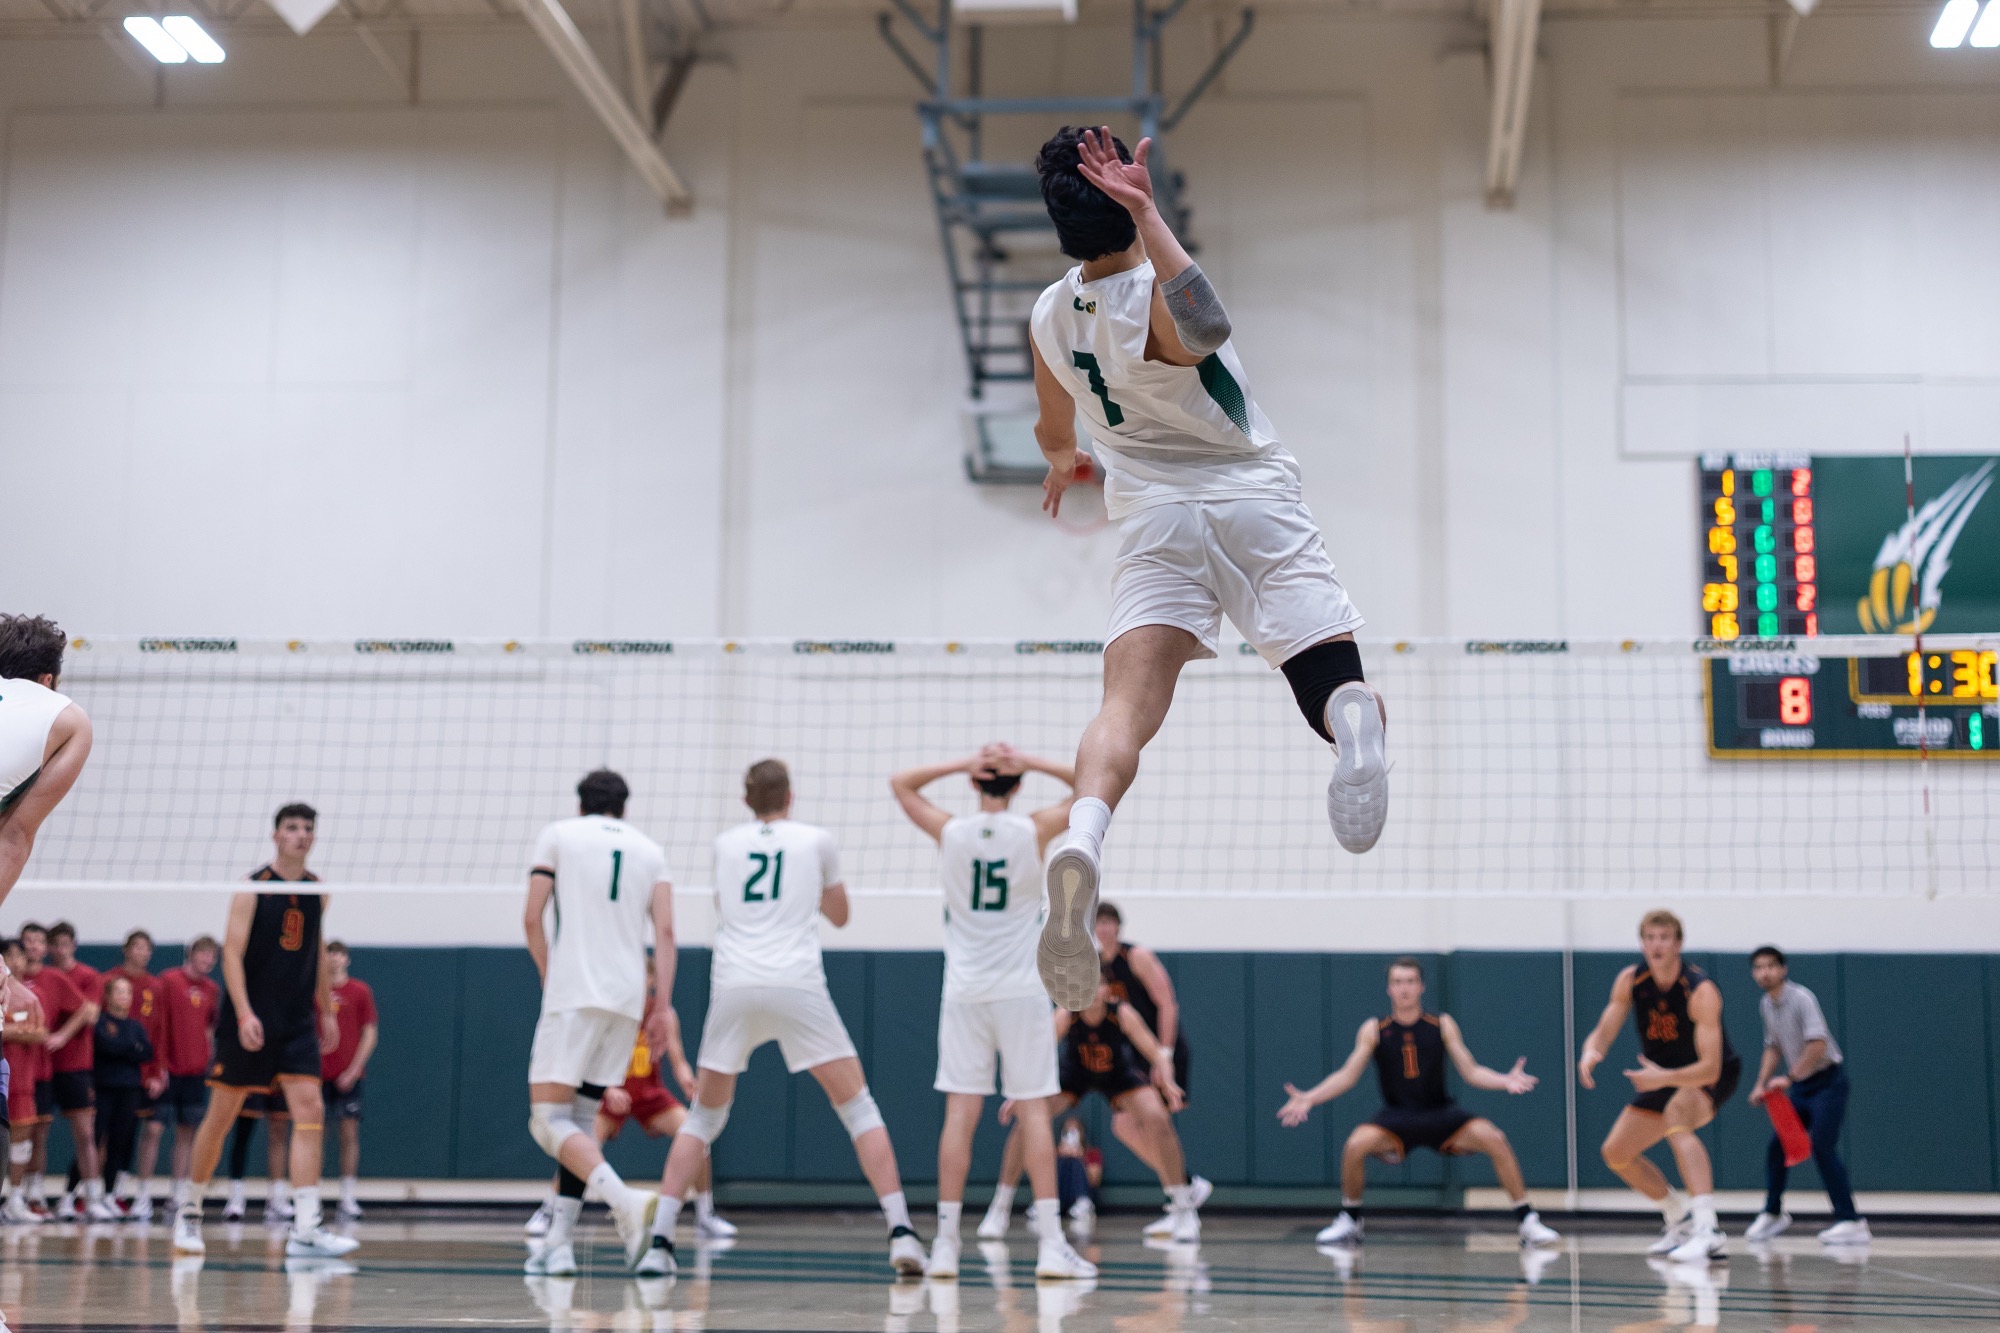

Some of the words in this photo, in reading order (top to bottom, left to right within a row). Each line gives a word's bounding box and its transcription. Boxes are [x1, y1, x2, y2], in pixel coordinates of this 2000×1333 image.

[1692, 639, 1797, 654] CONCORDIA
[1779, 677, 1812, 725] 8
[610, 850, 622, 900] 1
[744, 851, 783, 901] 21
[971, 858, 1007, 911] 15
[279, 908, 305, 951] 9
[1078, 1043, 1114, 1073] 12
[1401, 1043, 1420, 1079] 1
